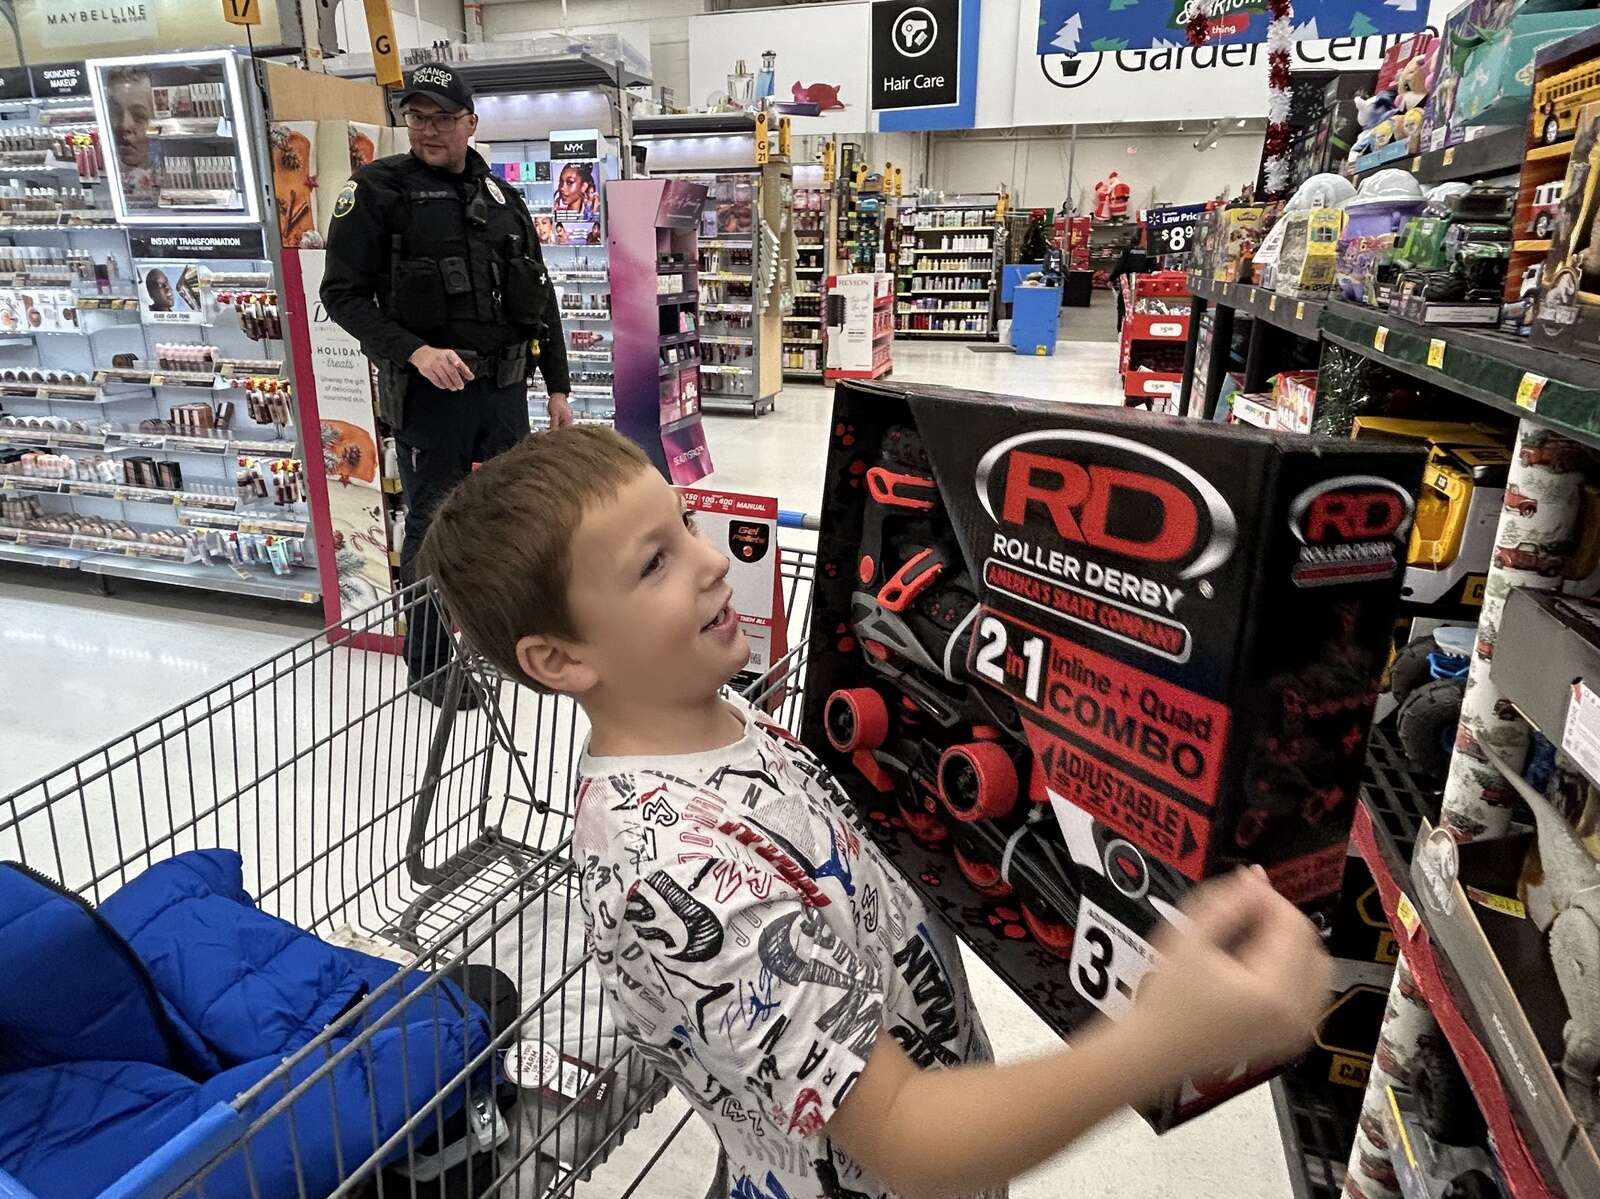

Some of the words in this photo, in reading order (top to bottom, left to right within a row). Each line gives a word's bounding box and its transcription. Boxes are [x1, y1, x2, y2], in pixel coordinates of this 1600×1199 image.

[46, 4, 146, 25] MAYBELLINE
[375, 35, 391, 55] G
[1116, 41, 1258, 72] Garde
[43, 68, 76, 80] SKINCARE
[50, 78, 77, 88] MAKEUP
[883, 77, 910, 92] Hair
[913, 74, 945, 88] Care
[564, 143, 584, 153] NYX
[757, 140, 766, 151] G
[757, 152, 767, 162] 21
[1162, 215, 1180, 224] Low
[1181, 212, 1200, 222] Pric
[150, 237, 178, 246] INSTANT
[179, 237, 241, 246] TRANSFORMATION
[316, 346, 362, 357] HOLIDAY
[736, 501, 767, 512] MANUAL
[1002, 449, 1199, 563] RD
[1305, 489, 1406, 544] RD
[993, 533, 1080, 583] ROLLER
[1084, 561, 1185, 614] DERBY
[975, 615, 1007, 685] 2
[1022, 636, 1045, 703] 1
[1052, 649, 1112, 695] Inline
[1138, 686, 1214, 742] Quad
[1048, 681, 1205, 781] COMBO
[1056, 751, 1181, 837] ADJUSTABLE
[521, 1050, 538, 1074] WARM
